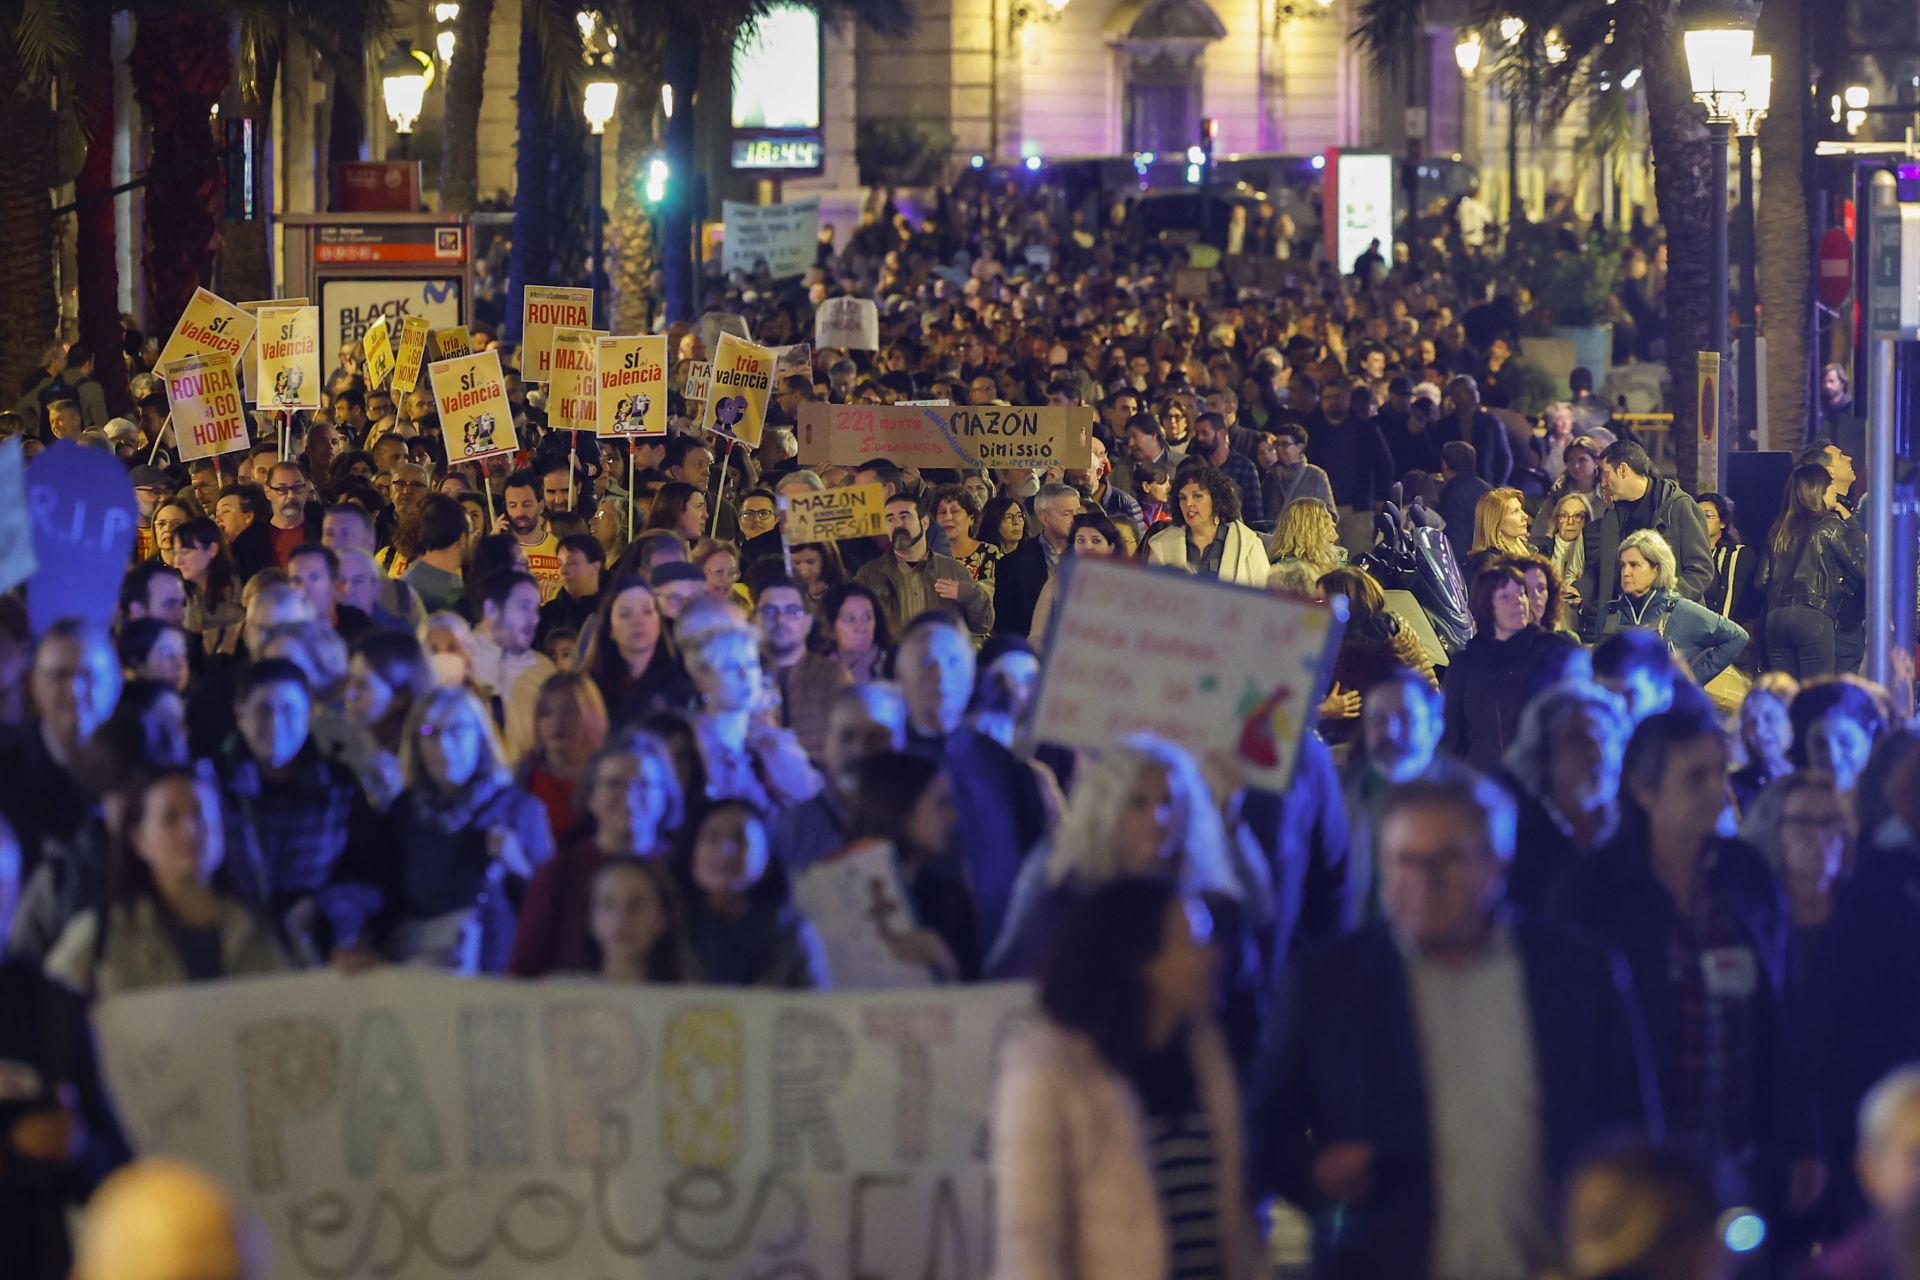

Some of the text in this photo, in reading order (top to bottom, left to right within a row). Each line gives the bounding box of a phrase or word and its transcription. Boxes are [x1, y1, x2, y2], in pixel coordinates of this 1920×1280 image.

[745, 141, 813, 165] 18:44
[340, 297, 410, 325] BLACK
[528, 304, 588, 326] ROVIRA
[602, 363, 662, 389] Valencià
[736, 354, 760, 373] tria
[171, 369, 233, 401] ROVIRA
[716, 368, 769, 390] valencià
[441, 380, 501, 414] Valencià
[193, 417, 242, 446] HOME
[836, 410, 874, 432] 221
[949, 409, 1038, 437] MAZÓN
